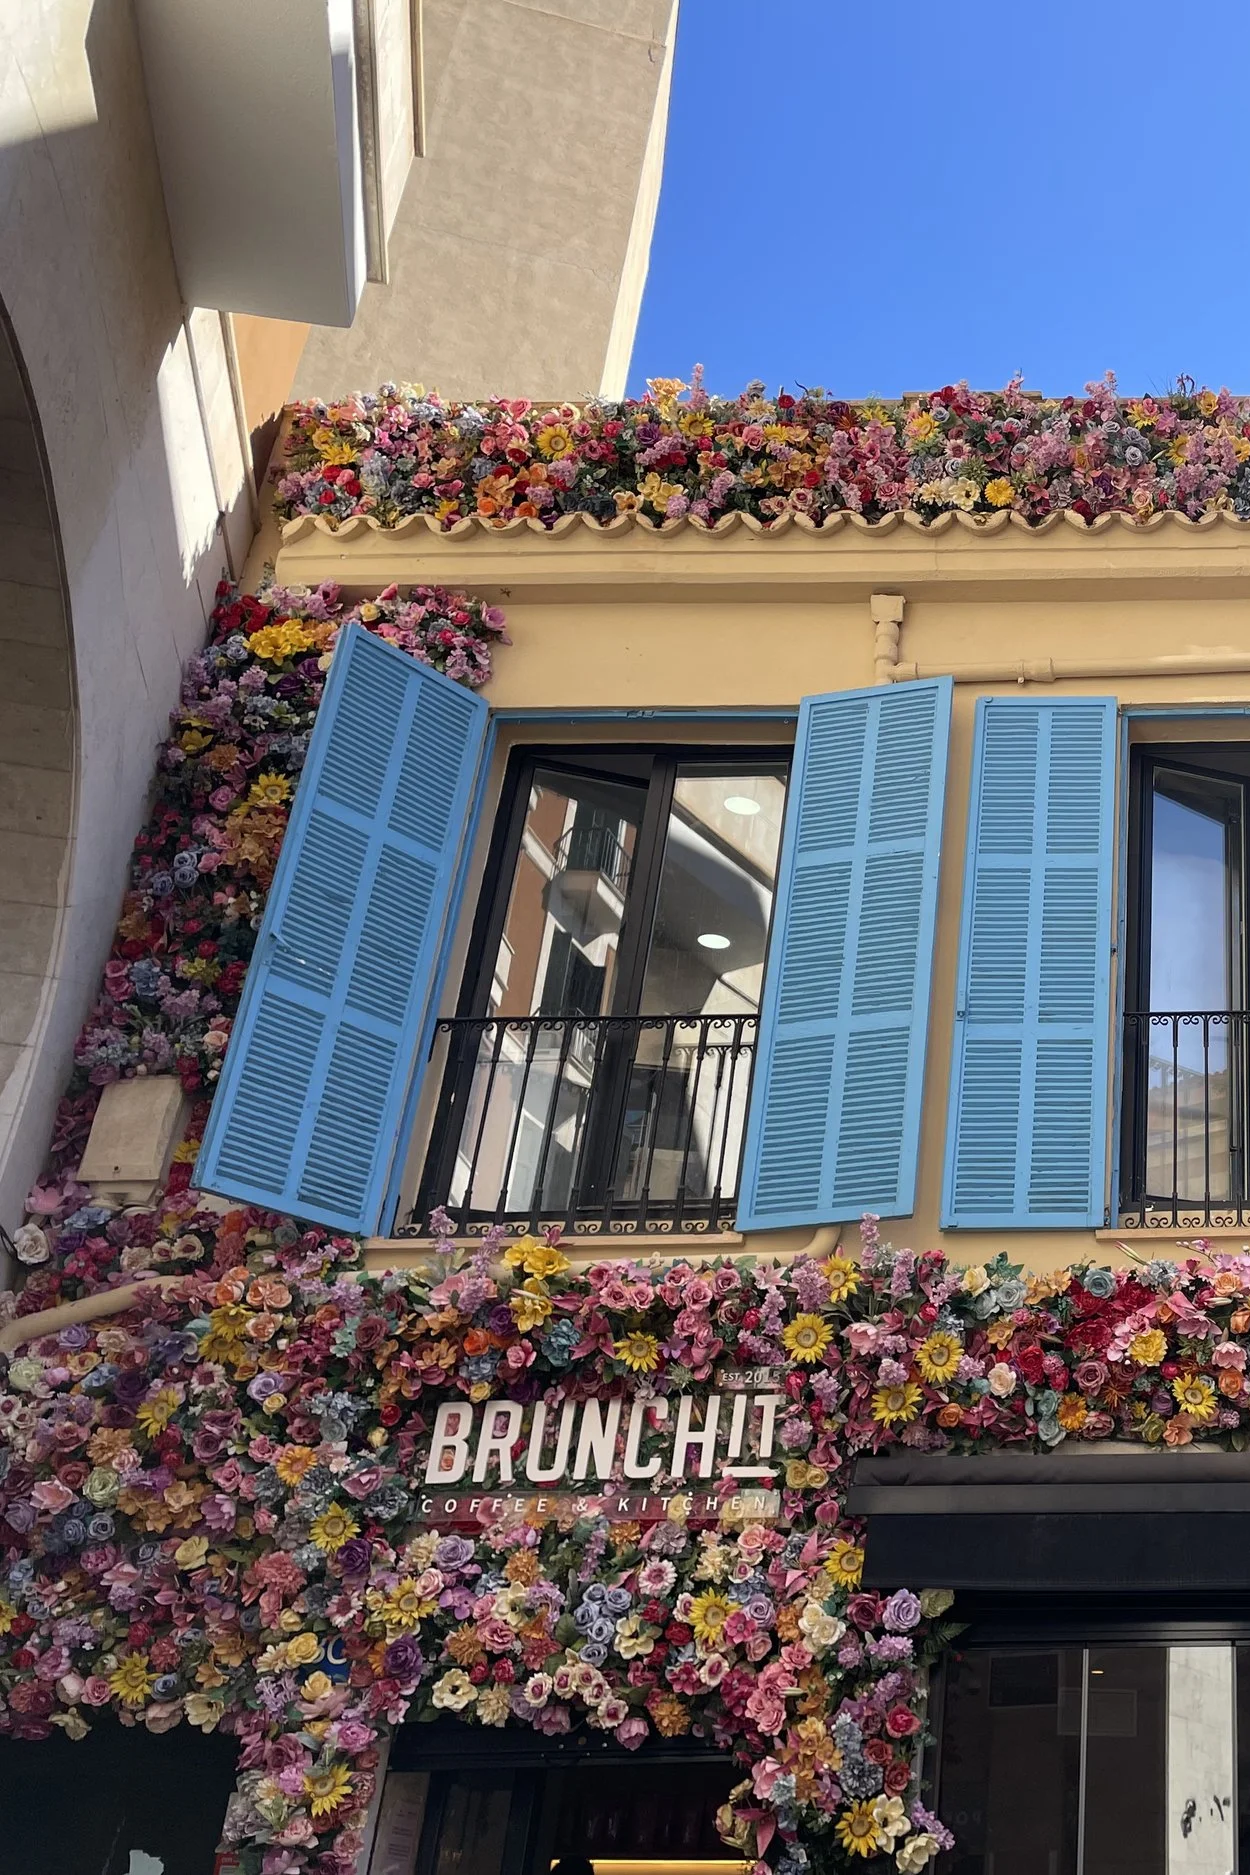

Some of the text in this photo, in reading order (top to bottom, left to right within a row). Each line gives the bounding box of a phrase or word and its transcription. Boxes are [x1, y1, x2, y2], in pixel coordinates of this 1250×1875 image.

[745, 1370, 780, 1384] 2015
[425, 1394, 781, 1484] BRUNCHIT
[421, 1495, 767, 1514] COFFEE & KITCHEN
